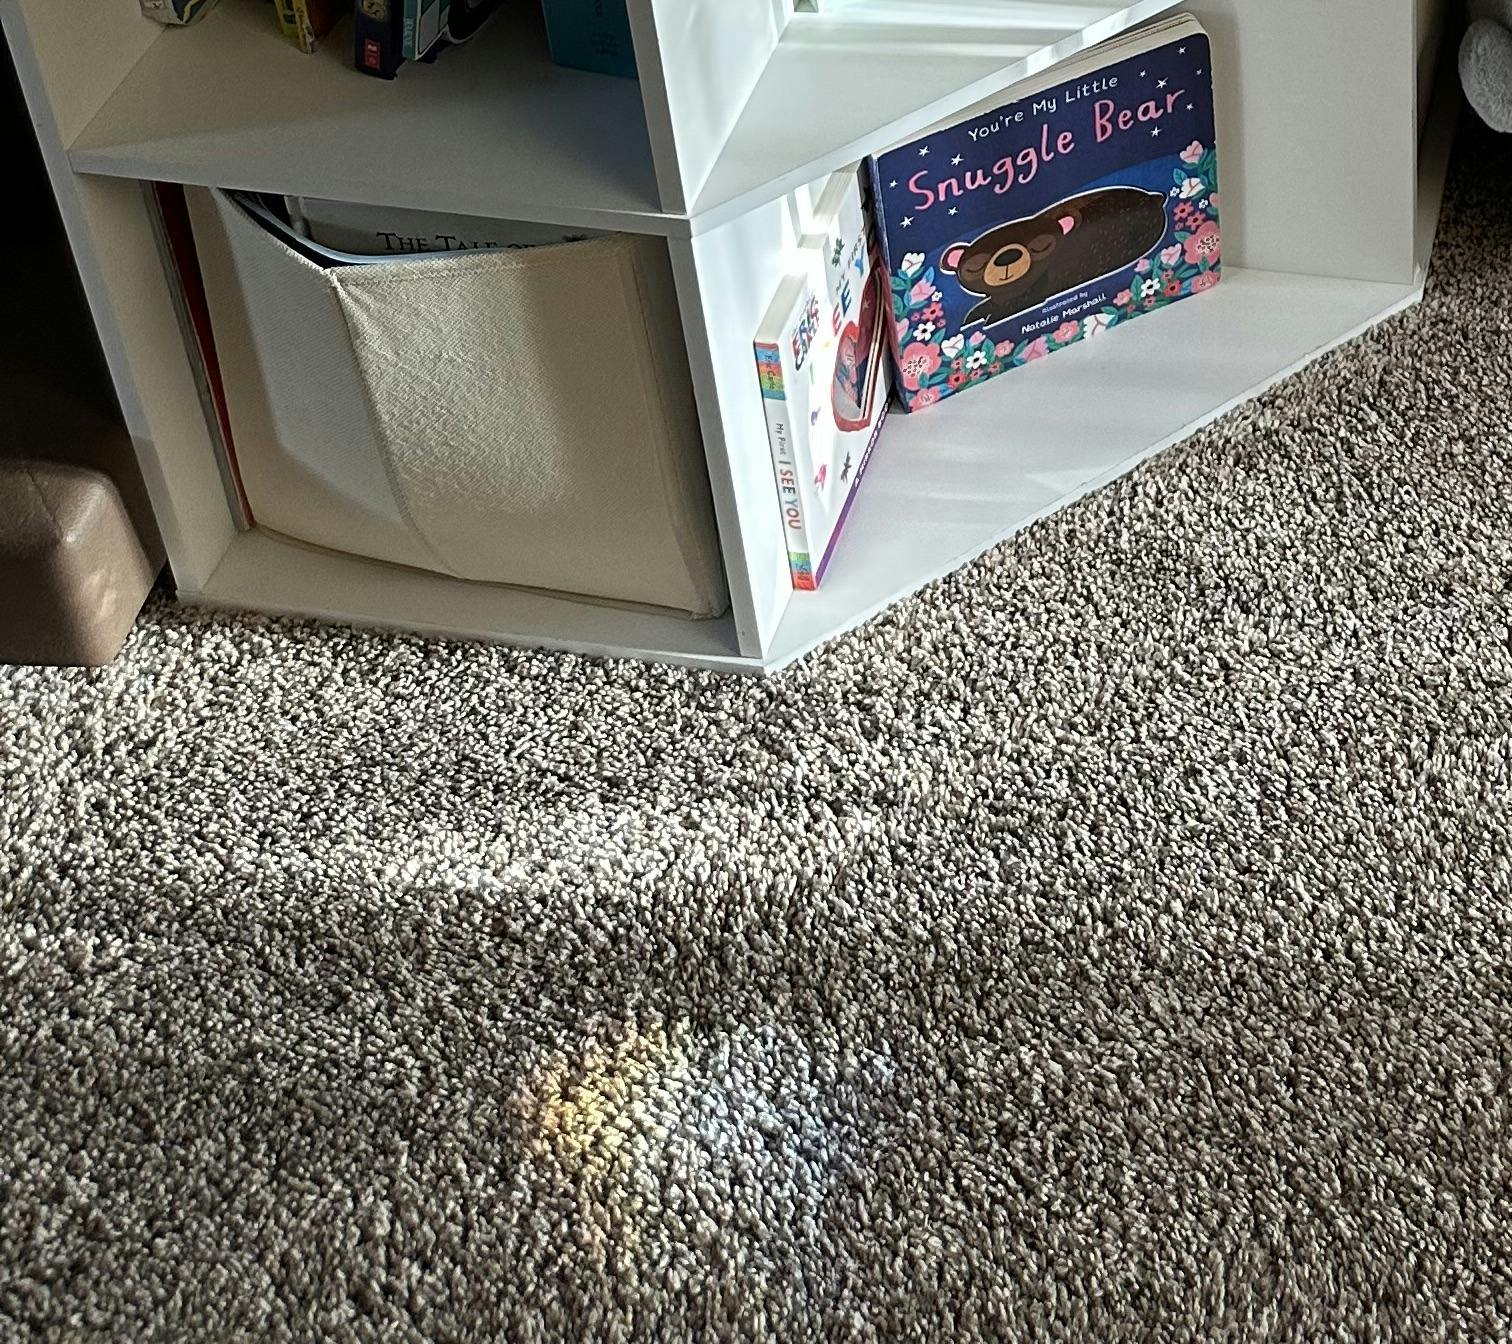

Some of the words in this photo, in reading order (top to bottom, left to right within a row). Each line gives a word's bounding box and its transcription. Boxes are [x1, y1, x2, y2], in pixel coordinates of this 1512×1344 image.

[968, 112, 1024, 142] You're
[1033, 97, 1057, 116] My
[1065, 76, 1119, 103] Little
[908, 124, 1075, 210] Snuggle
[1093, 89, 1185, 144] Bear
[377, 232, 428, 251] THE
[1021, 315, 1060, 334] Natalie
[1062, 293, 1107, 318] Marshall
[779, 467, 796, 496] SEE
[783, 498, 802, 531] YOU
